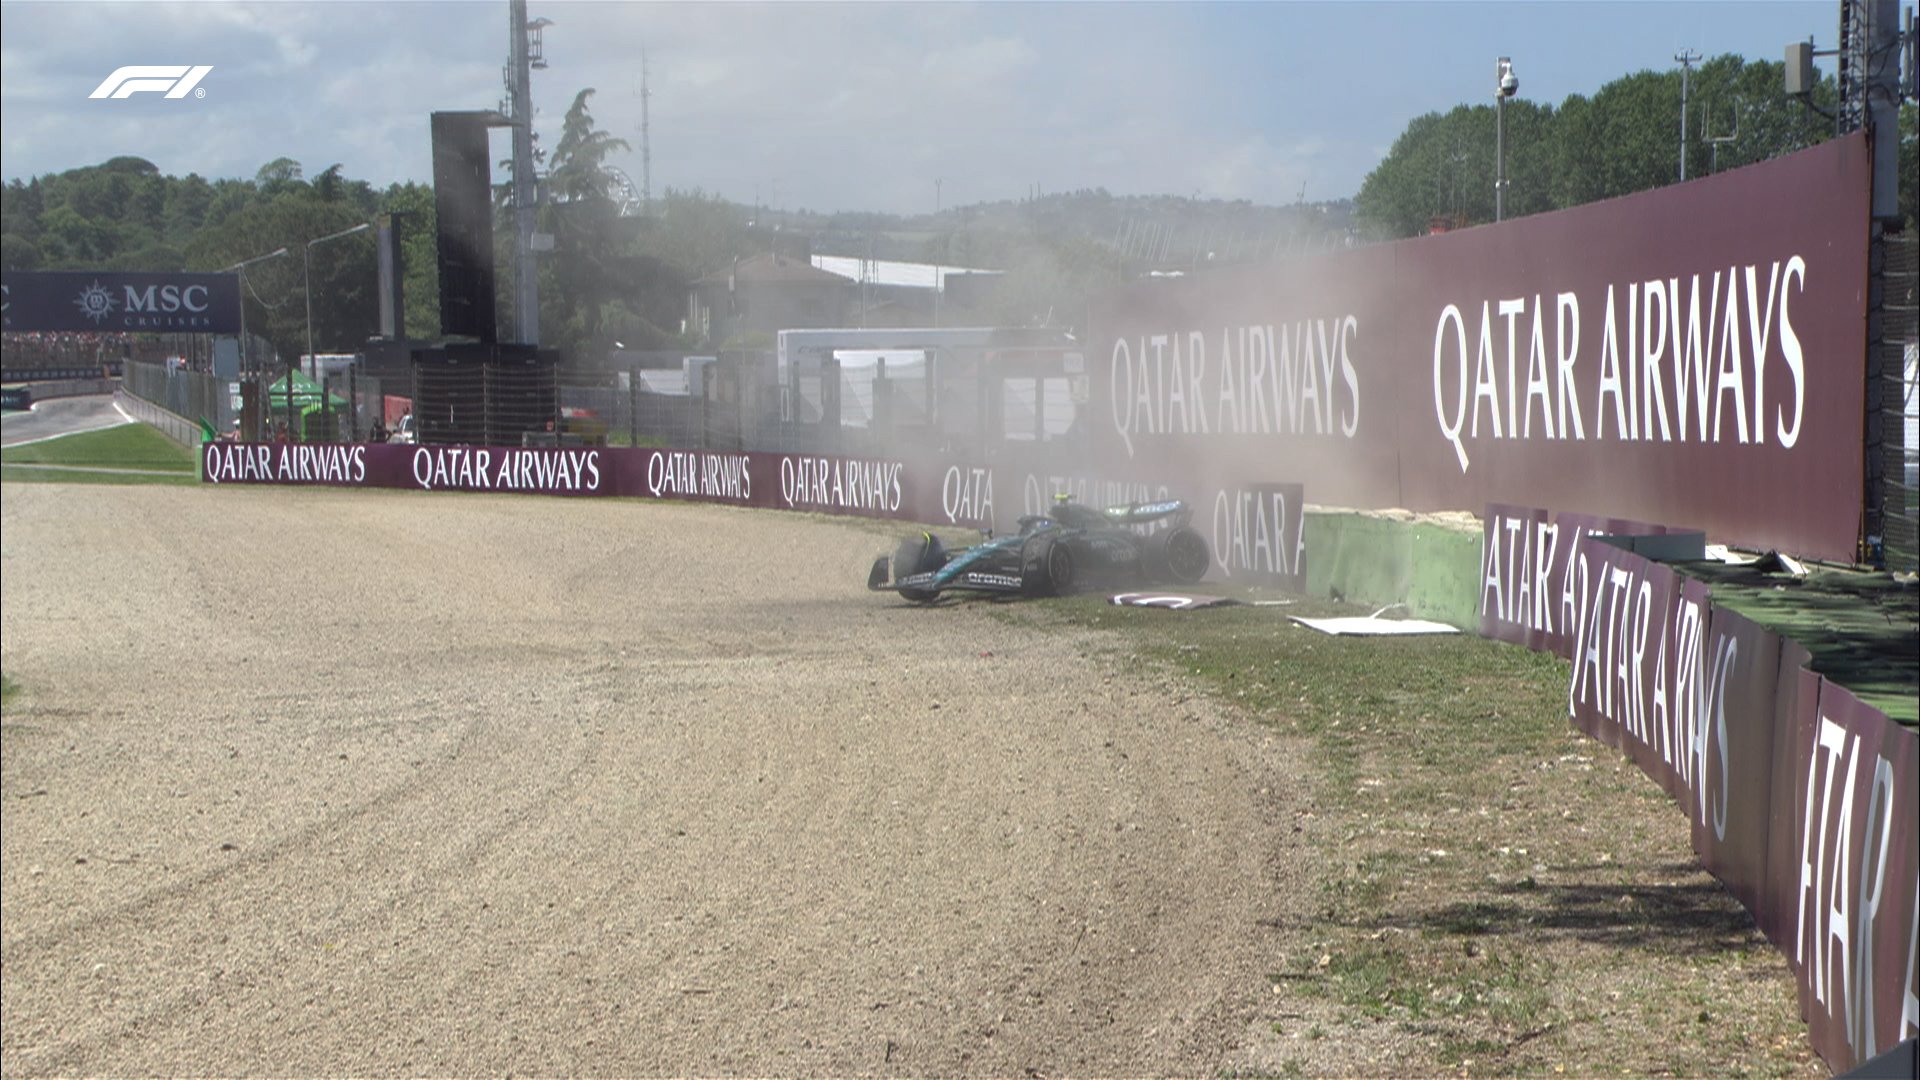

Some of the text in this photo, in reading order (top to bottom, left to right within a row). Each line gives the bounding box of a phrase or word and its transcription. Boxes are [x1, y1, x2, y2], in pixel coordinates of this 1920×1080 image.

[124, 285, 208, 312] MSC
[125, 317, 209, 326] CRUISES
[1112, 315, 1359, 459] QATAR AIRWAYS
[1434, 255, 1805, 474] QATAR AIRWAYS
[206, 445, 365, 483] QATAR AIRWAYS
[413, 447, 599, 490] QATAR AIRWAYS
[648, 452, 750, 499] QATAR AIRWAYS
[781, 457, 903, 511] QATAR AIRWAYS
[1214, 489, 1288, 577] QATAR
[968, 572, 1022, 588] aramco
[1480, 515, 1558, 633] ATAR
